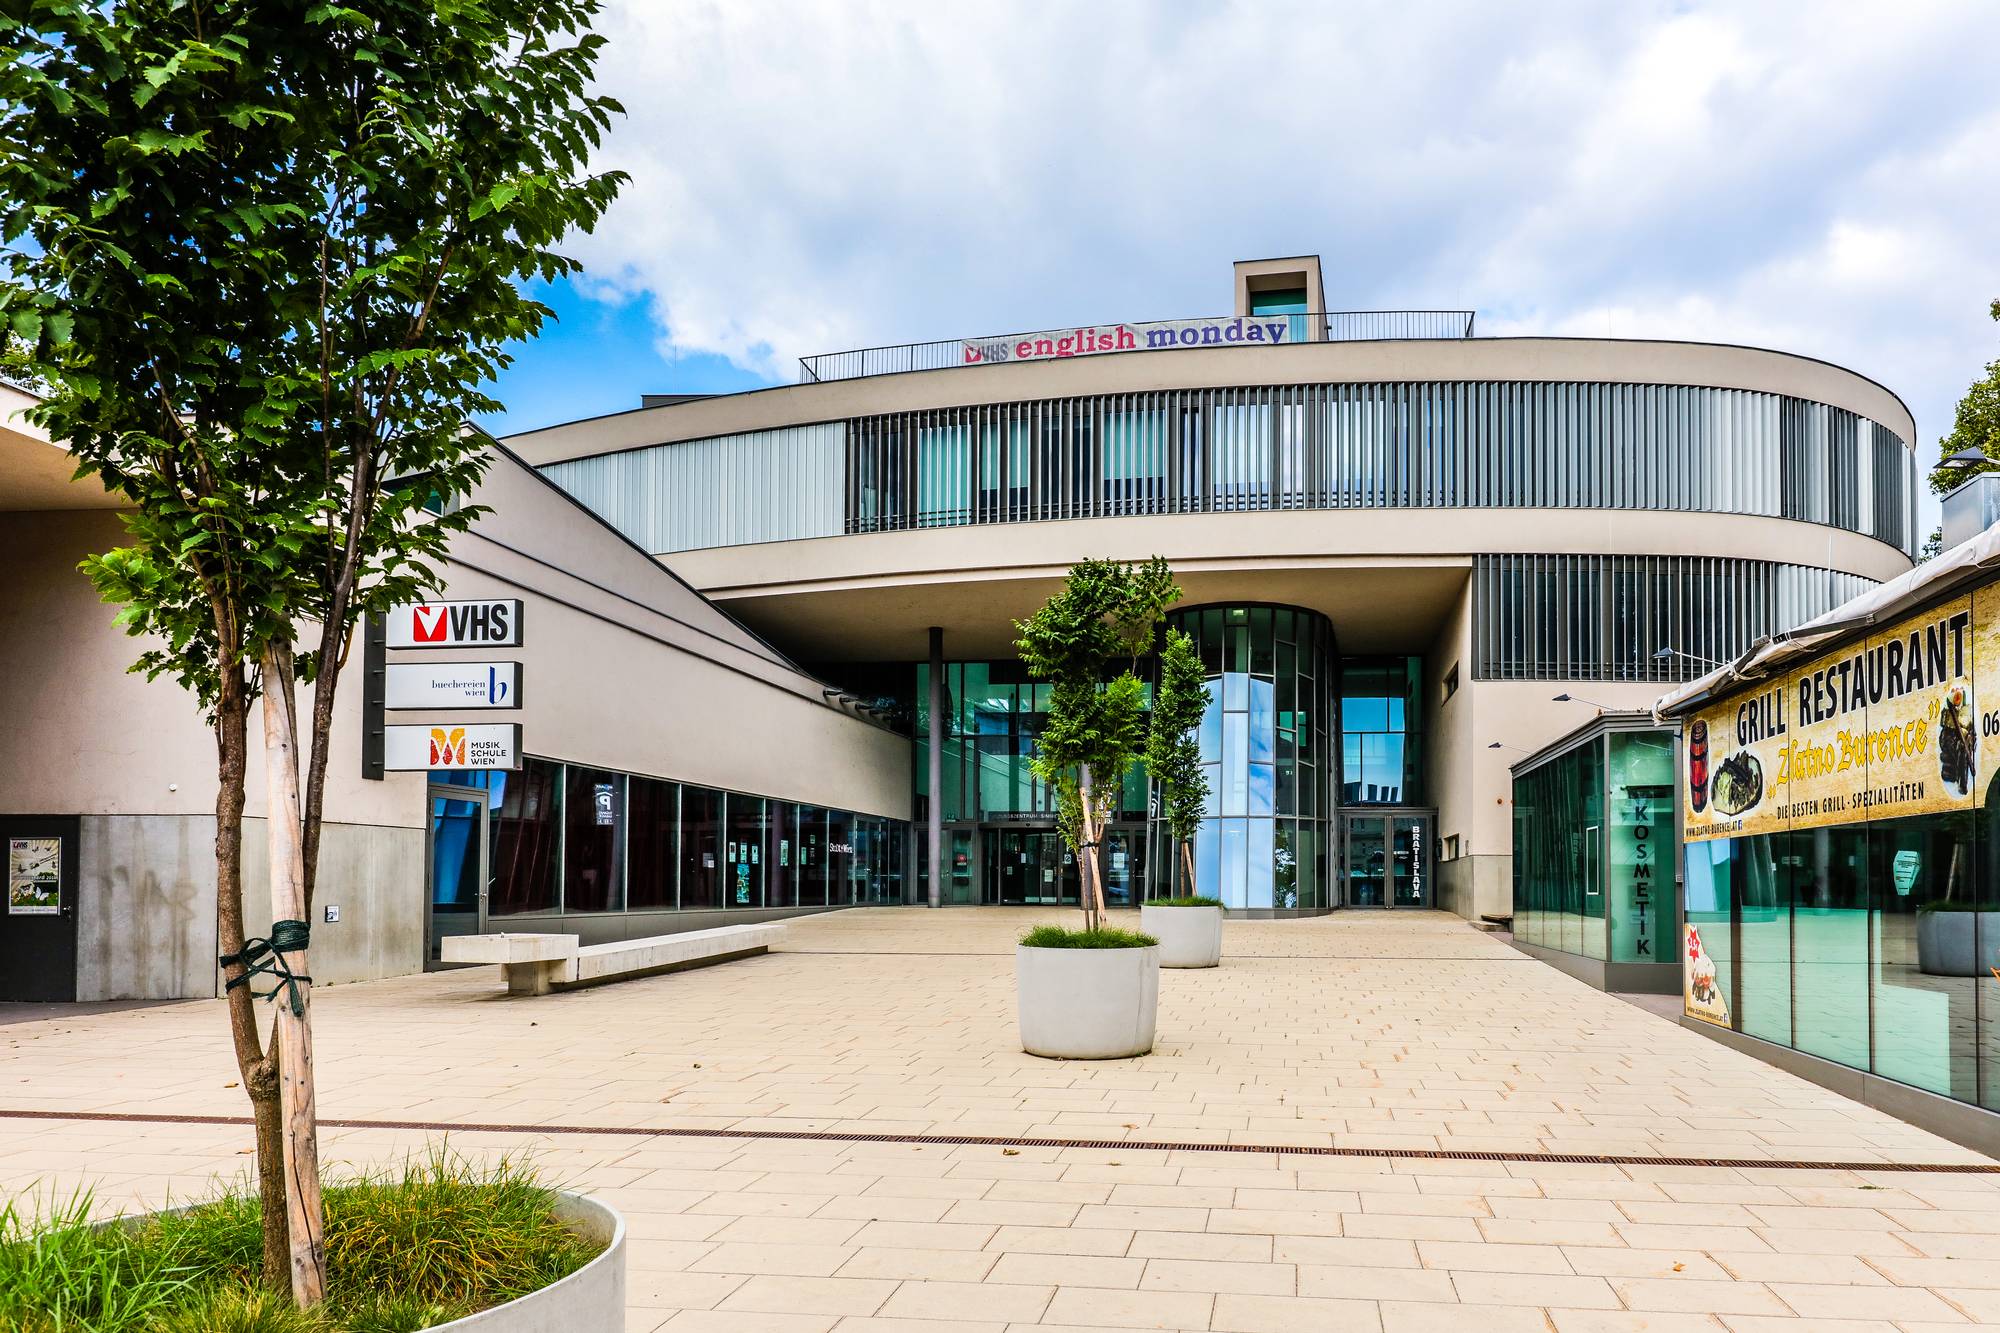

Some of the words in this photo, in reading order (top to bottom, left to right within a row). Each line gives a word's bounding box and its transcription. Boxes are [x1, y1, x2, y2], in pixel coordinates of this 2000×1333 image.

[981, 343, 1009, 362] VHS
[1015, 326, 1136, 357] english
[1146, 319, 1287, 347] monday
[449, 603, 509, 642] VHS
[432, 679, 486, 689] buechereien
[464, 688, 486, 696] wien
[1737, 687, 1786, 747] GRILL
[1799, 610, 1969, 728] RESTAURANT
[470, 749, 507, 757] SCHULE
[471, 741, 501, 749] MUSIK
[1777, 805, 1789, 820] DIE
[1792, 799, 1819, 817] BESTEN
[1823, 795, 1845, 813] GRILL
[1852, 781, 1925, 809] SPEZIALITÄTEN
[1412, 826, 1421, 898] BRATISLAVA
[1632, 805, 1651, 955] KOSMETIK
